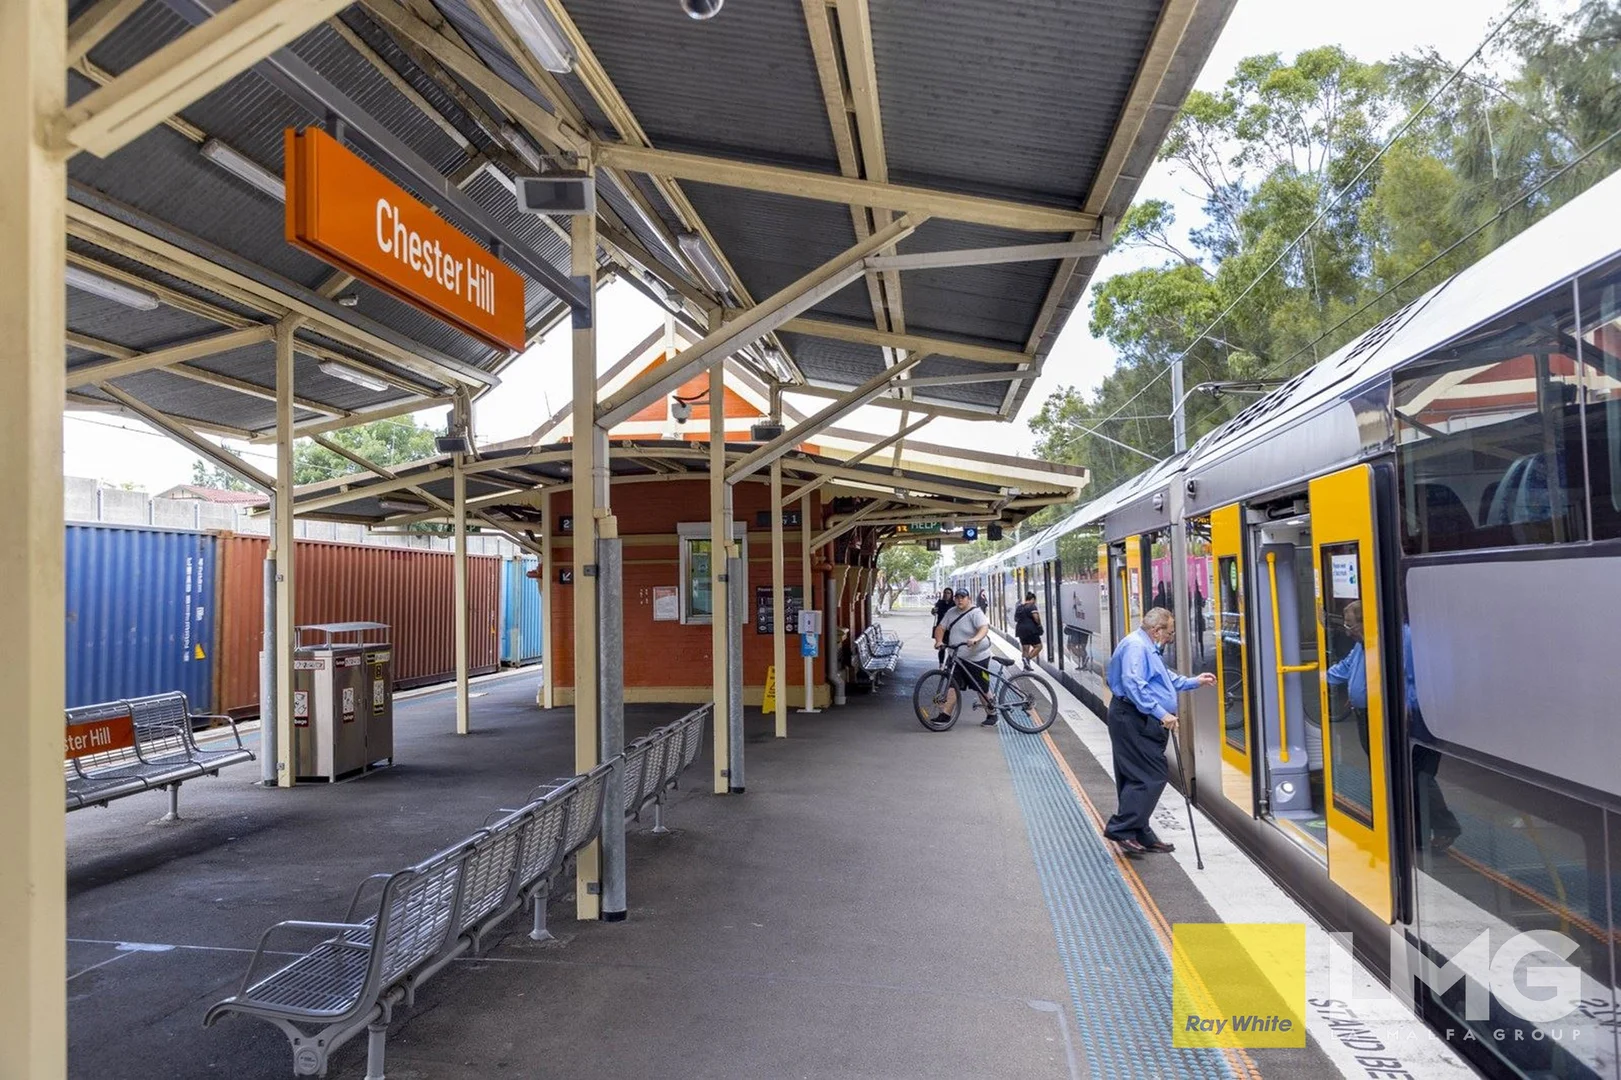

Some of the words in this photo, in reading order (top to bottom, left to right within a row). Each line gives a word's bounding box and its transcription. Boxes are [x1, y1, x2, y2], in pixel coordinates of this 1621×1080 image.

[376, 198, 463, 295] Chester
[467, 257, 495, 316] Hill
[563, 519, 571, 529] 2
[89, 726, 111, 747] Hill
